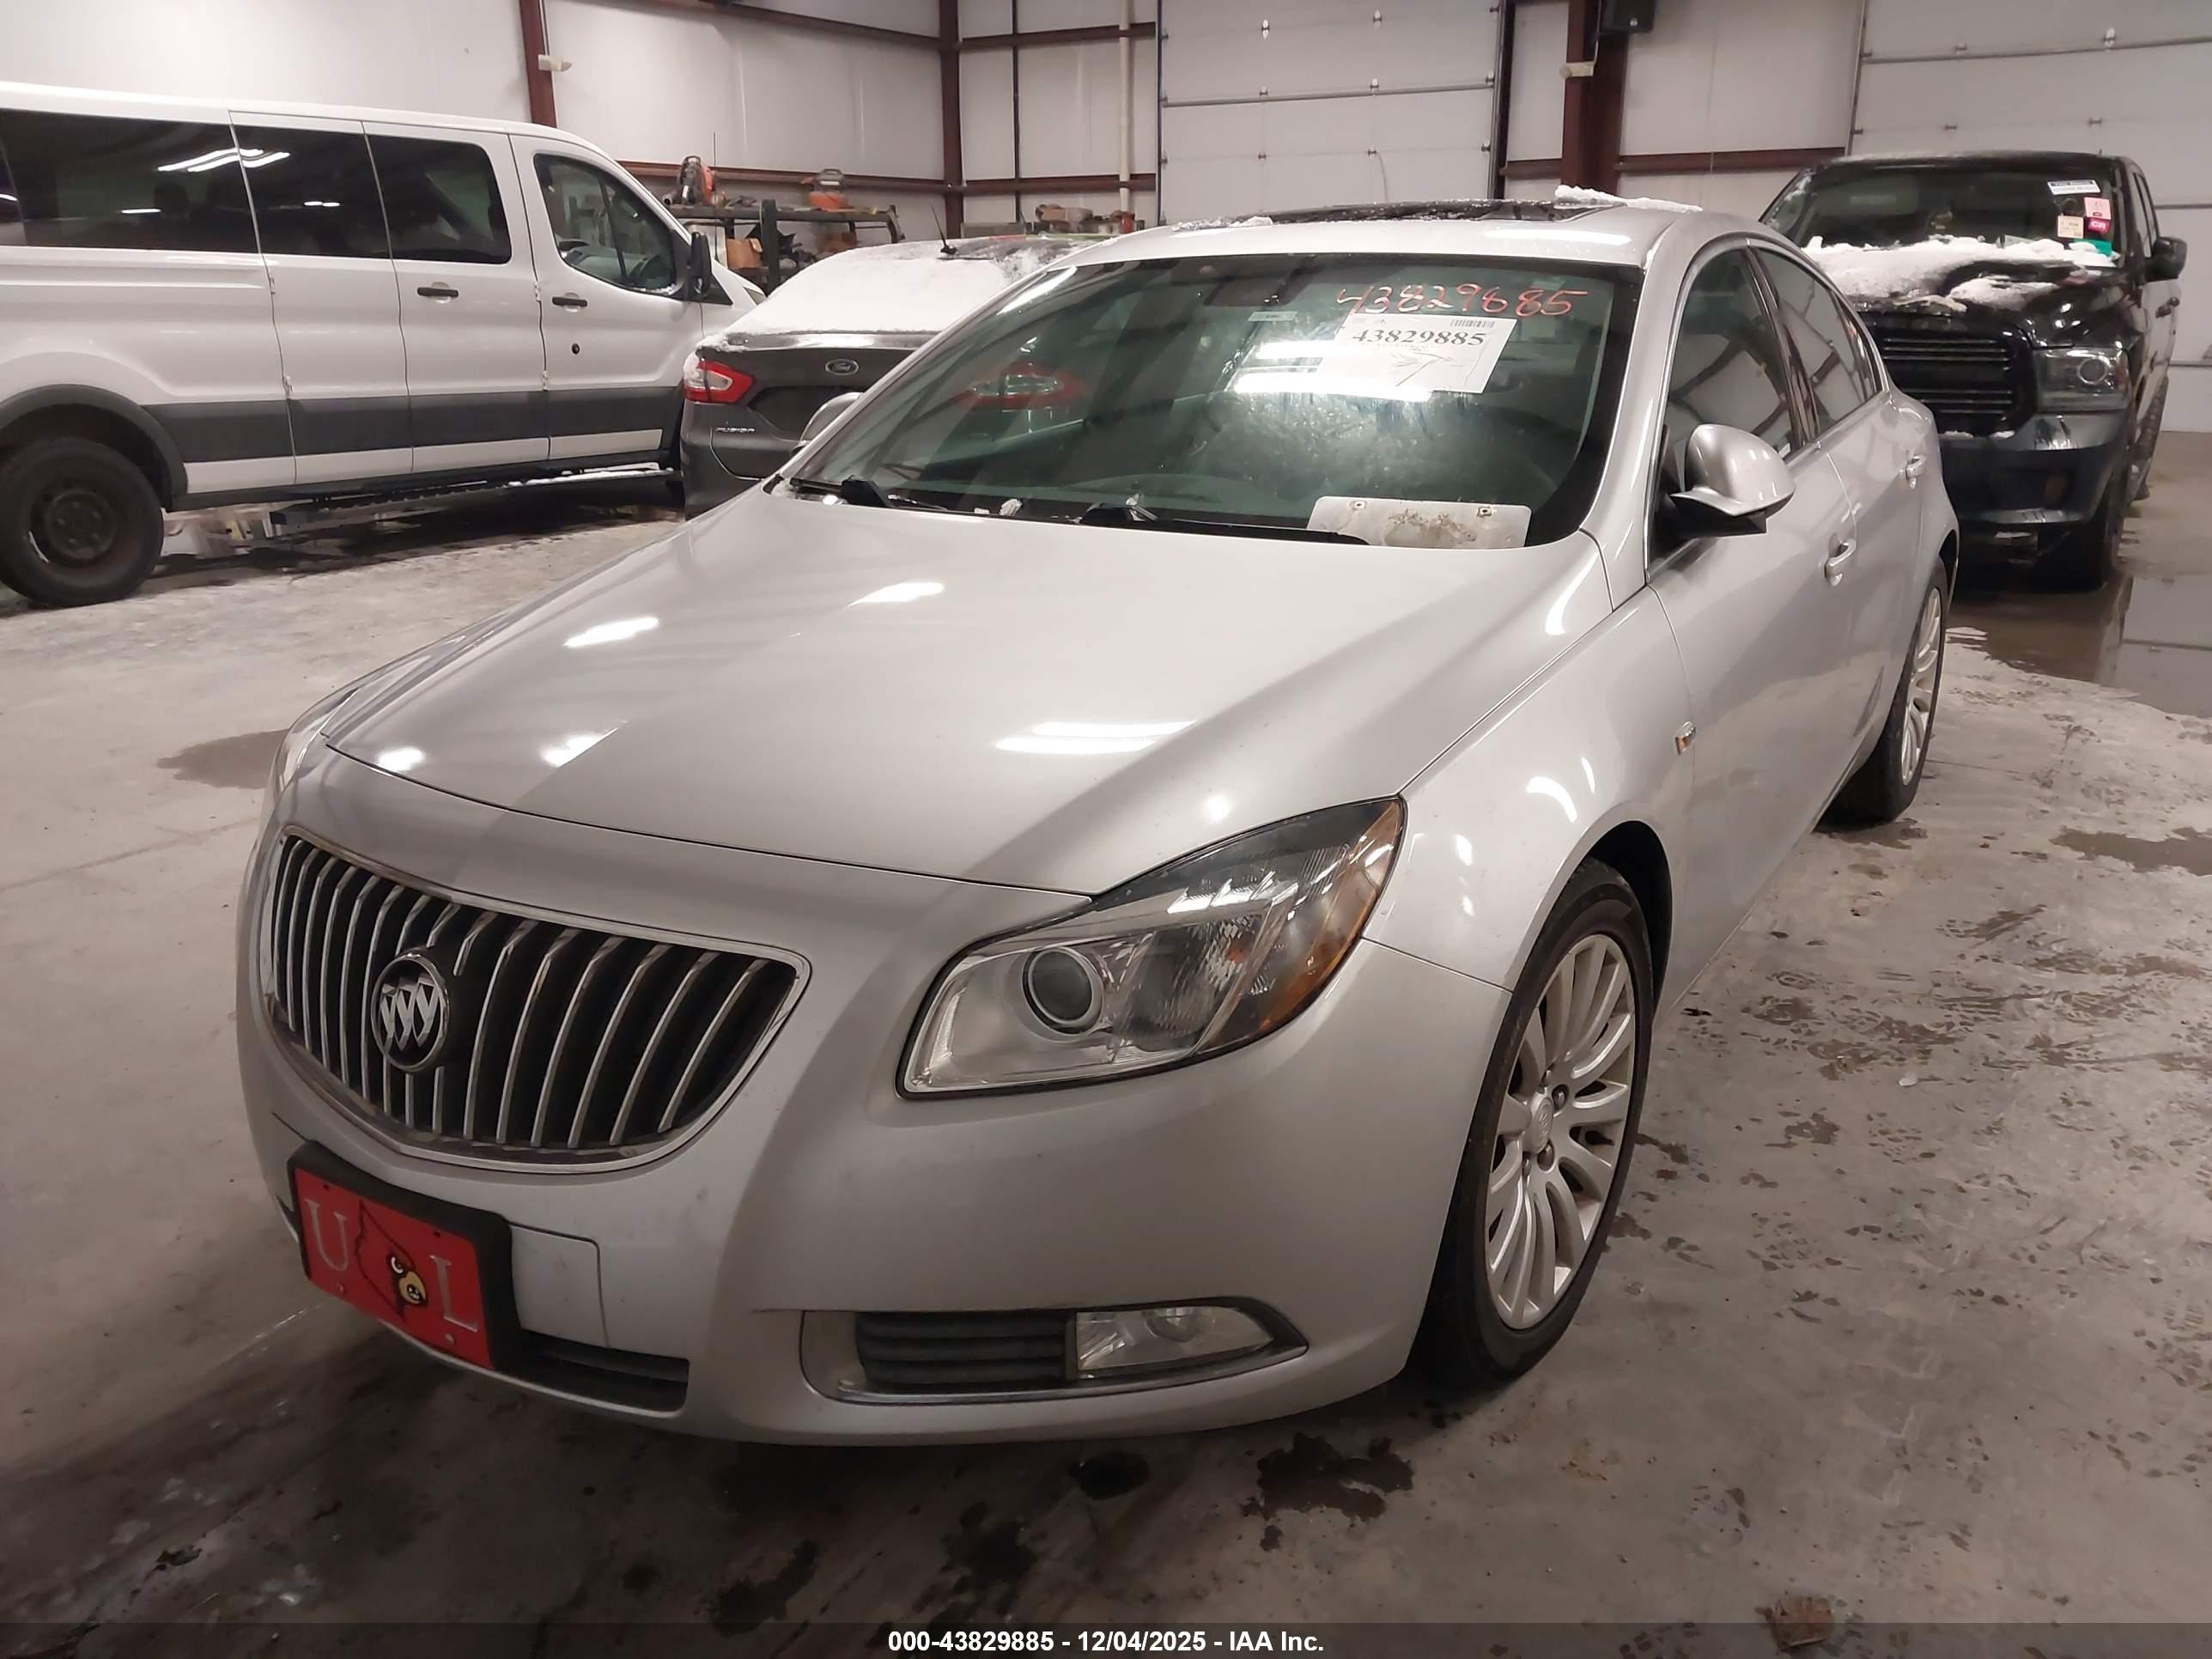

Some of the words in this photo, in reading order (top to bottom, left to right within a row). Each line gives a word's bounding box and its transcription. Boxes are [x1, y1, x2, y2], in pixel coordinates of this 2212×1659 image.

[1352, 329, 1487, 347] 43829885
[304, 1198, 348, 1272] U
[429, 1254, 478, 1334] L
